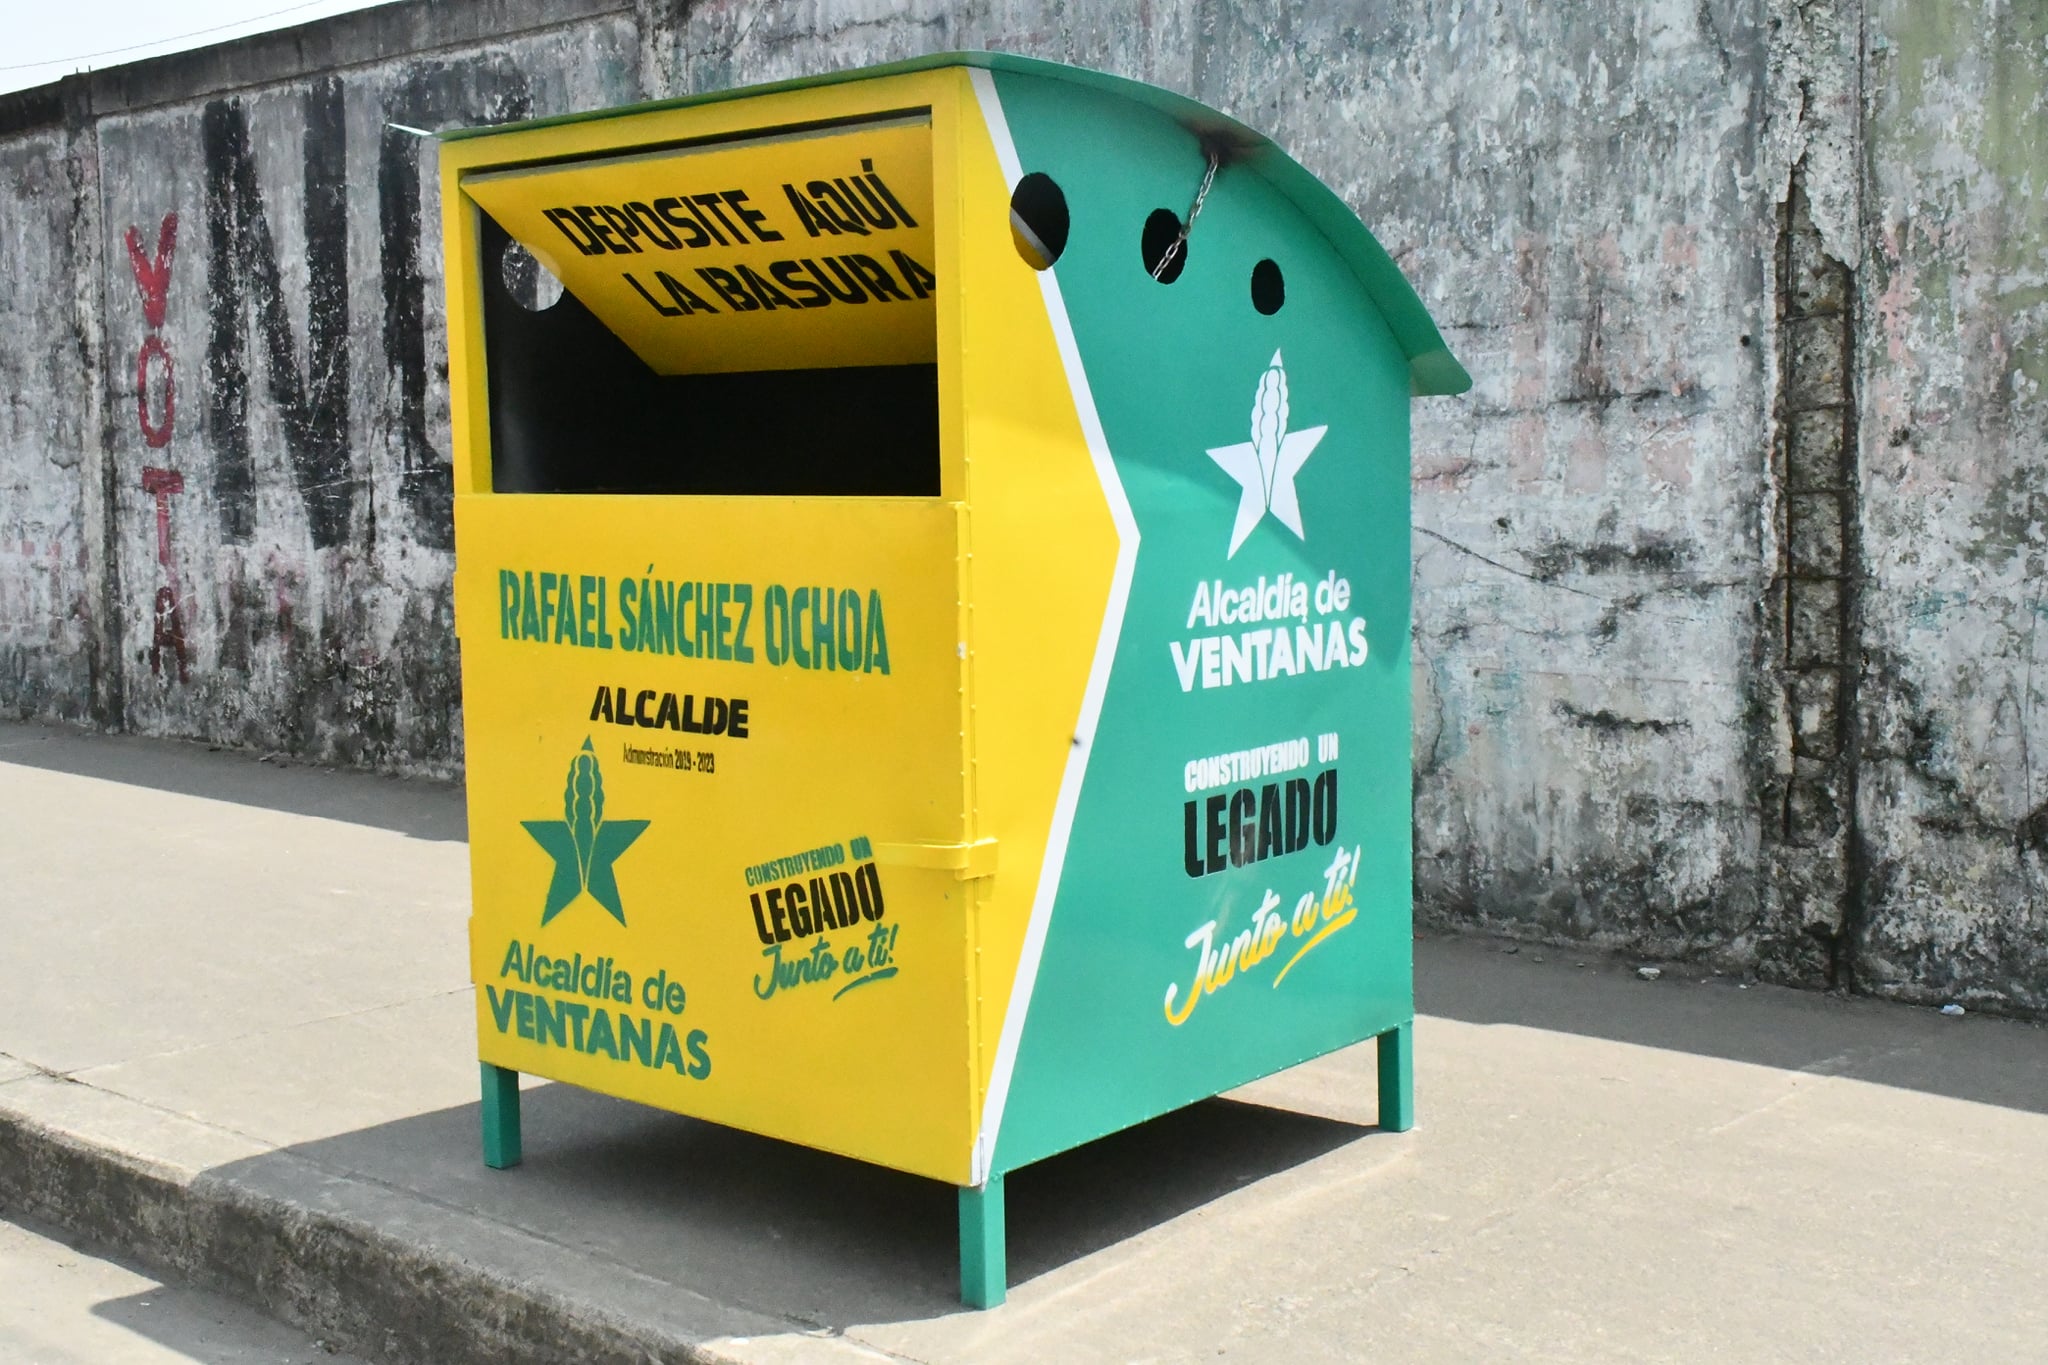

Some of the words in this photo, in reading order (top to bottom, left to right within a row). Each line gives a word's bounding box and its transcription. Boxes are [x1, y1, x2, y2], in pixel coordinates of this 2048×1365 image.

[541, 189, 785, 256] DEPOSITE
[782, 158, 918, 237] AQUÍ
[622, 270, 720, 317] LA
[695, 249, 936, 312] BASURA
[499, 569, 613, 649] RAFAEL
[619, 563, 754, 663] SÁNCHEZ
[764, 584, 891, 675] OCHOA
[1186, 572, 1308, 629] Alcaldía
[1315, 569, 1351, 616] de
[1169, 616, 1368, 692] VENTANAS
[590, 686, 749, 738] ALCALDE
[675, 748, 691, 771] 2019
[697, 751, 715, 774] 2023
[1184, 737, 1309, 793] CONSTRUYENDO
[1318, 732, 1338, 764] UN
[745, 843, 845, 887] CONSTRUYENDO
[850, 835, 873, 861] UN
[1184, 768, 1337, 879] LEGADO
[750, 862, 885, 945] LEGADO
[1164, 889, 1287, 1026] Junto
[1292, 891, 1320, 937] a
[1323, 844, 1361, 920] ti!
[500, 940, 633, 1006] Alcaldía
[642, 969, 687, 1015] de
[754, 936, 839, 1000] Junto
[843, 947, 865, 974] a
[868, 922, 899, 968] ti!
[486, 984, 712, 1081] VENTANAS
